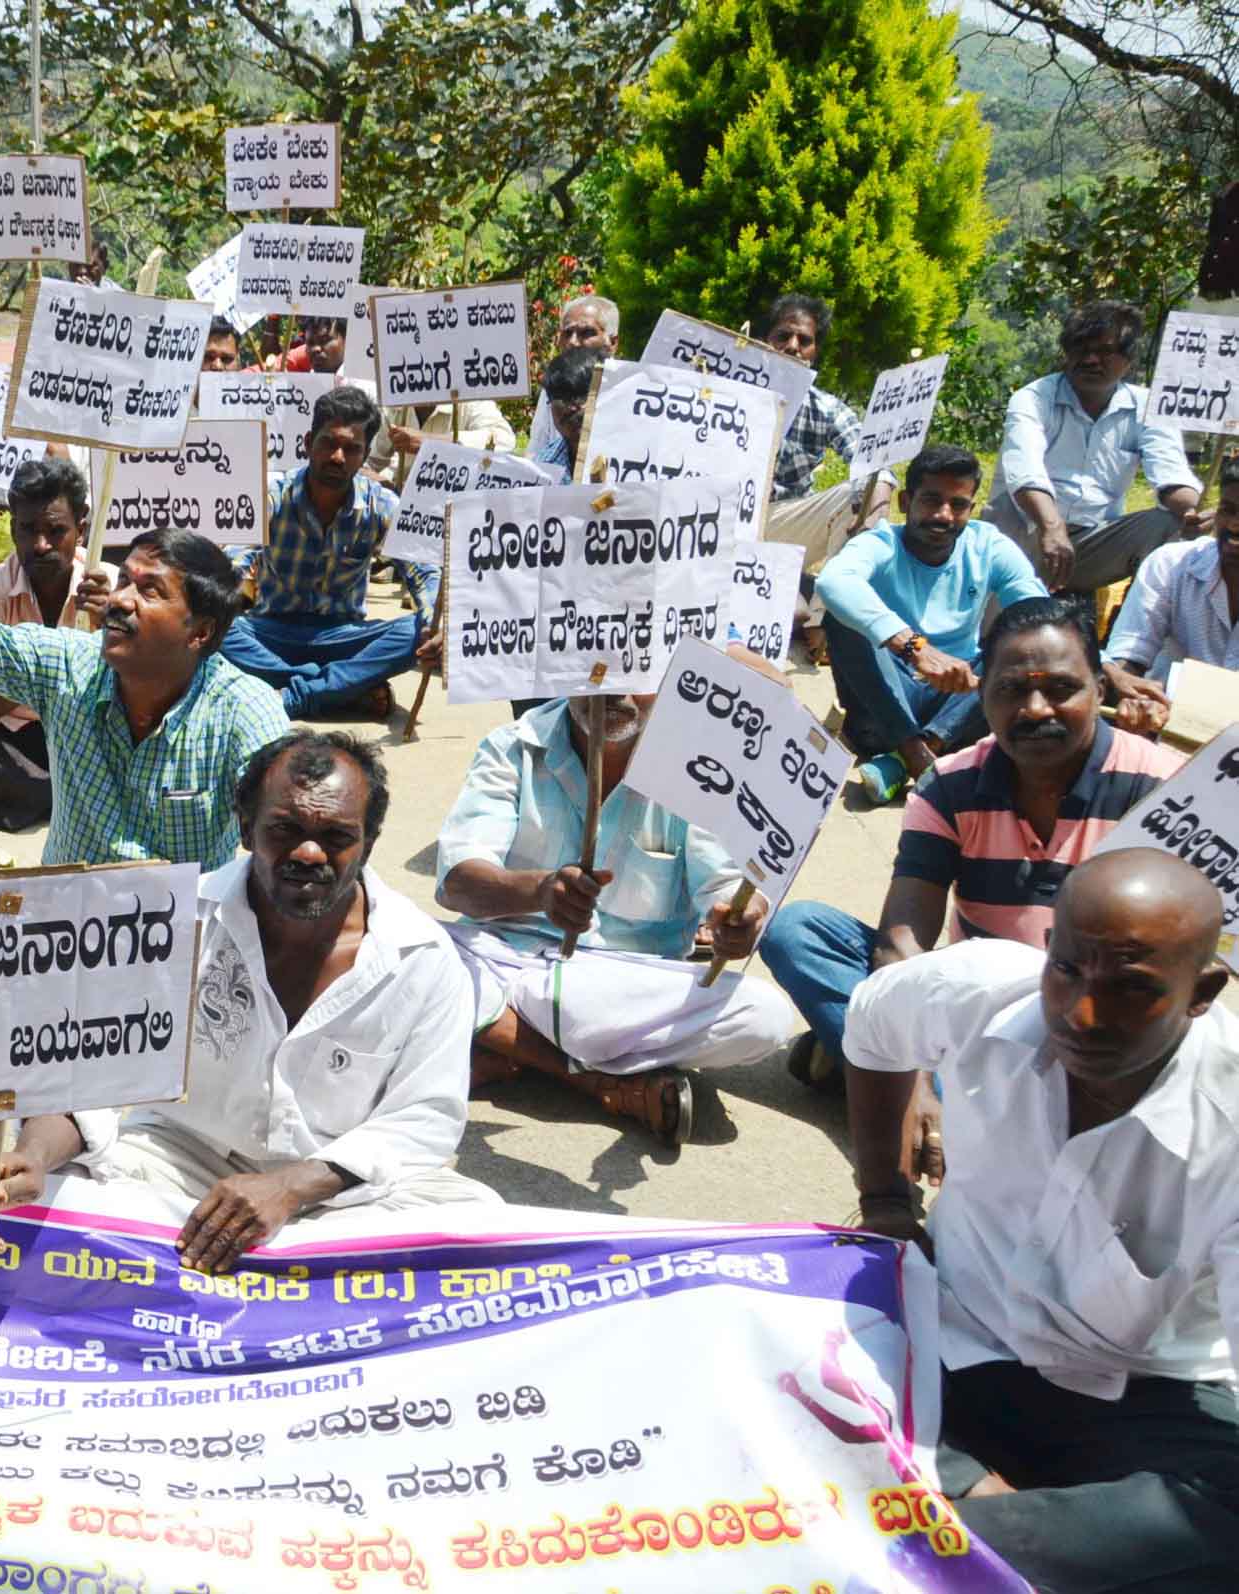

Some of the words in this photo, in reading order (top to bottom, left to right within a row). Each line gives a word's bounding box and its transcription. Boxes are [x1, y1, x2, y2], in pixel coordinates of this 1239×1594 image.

[233, 134, 278, 161] ಬೇಕೇ
[287, 133, 329, 160] ಬೇಕು
[22, 171, 77, 198] ಜನಾಂಗದ
[233, 172, 281, 201] ನ್ಯಾಯ
[289, 169, 328, 190] ಬೇಕು
[306, 235, 355, 264] ಕೆಣಕದಿರಿ
[49, 296, 133, 359] “ಕೆಣಕದಿರಿ,
[144, 314, 200, 362] ಕೆಣಕದಿರಿ
[385, 305, 421, 345] ನಮ್ಮ
[427, 303, 459, 331] ಕುಲ
[467, 296, 516, 327] ಕಸುಬು
[388, 350, 452, 395] ನಮಗೆ
[463, 347, 519, 388] ಕೊಡಿ
[1172, 328, 1208, 369] ನಮ್ಮ
[28, 364, 113, 427] ಬಡವರನ್ನು
[221, 384, 311, 416] ನಮ್ಮನ್ನು
[633, 383, 750, 452] ನಮ್ಮನ್ನು
[1157, 380, 1232, 422] ನಮಗೆ
[415, 453, 470, 493] ಭೋವಿ
[215, 494, 256, 530] ಬಿಡಿ
[468, 509, 567, 582] ಭೋವಿ
[584, 495, 722, 567] ಜನಾಂಗದ
[461, 608, 538, 659] ಮೇಲಿನ
[549, 599, 654, 674] ದೌರ್ಜನ್ಯಕ್ಕೆ
[677, 669, 773, 761] ಅರಣ್ಯ
[9, 998, 174, 1068] ಜಯವಾಗಲಿ
[43, 1248, 158, 1286] ಯುವ
[333, 1268, 417, 1304] (ರಿ.)
[131, 1308, 223, 1341] ಹಾಗೂ
[140, 1339, 247, 1373] ನಗರ
[265, 1317, 384, 1363] ಘಟಕ
[81, 1367, 365, 1410] ಸಹಯೋಗದೊಂದಿಗೆ
[64, 1429, 266, 1462] ಸಮಾಜದಲ್ಲಿ
[475, 1384, 548, 1422] ಬಿಡಿ
[60, 1465, 142, 1497] ಕಲ್ಲು
[385, 1452, 509, 1501] ನಮಗೆ
[532, 1425, 663, 1483] ಕೊಡಿ”
[280, 1526, 430, 1591] ಹಕ್ಕನ್ನು
